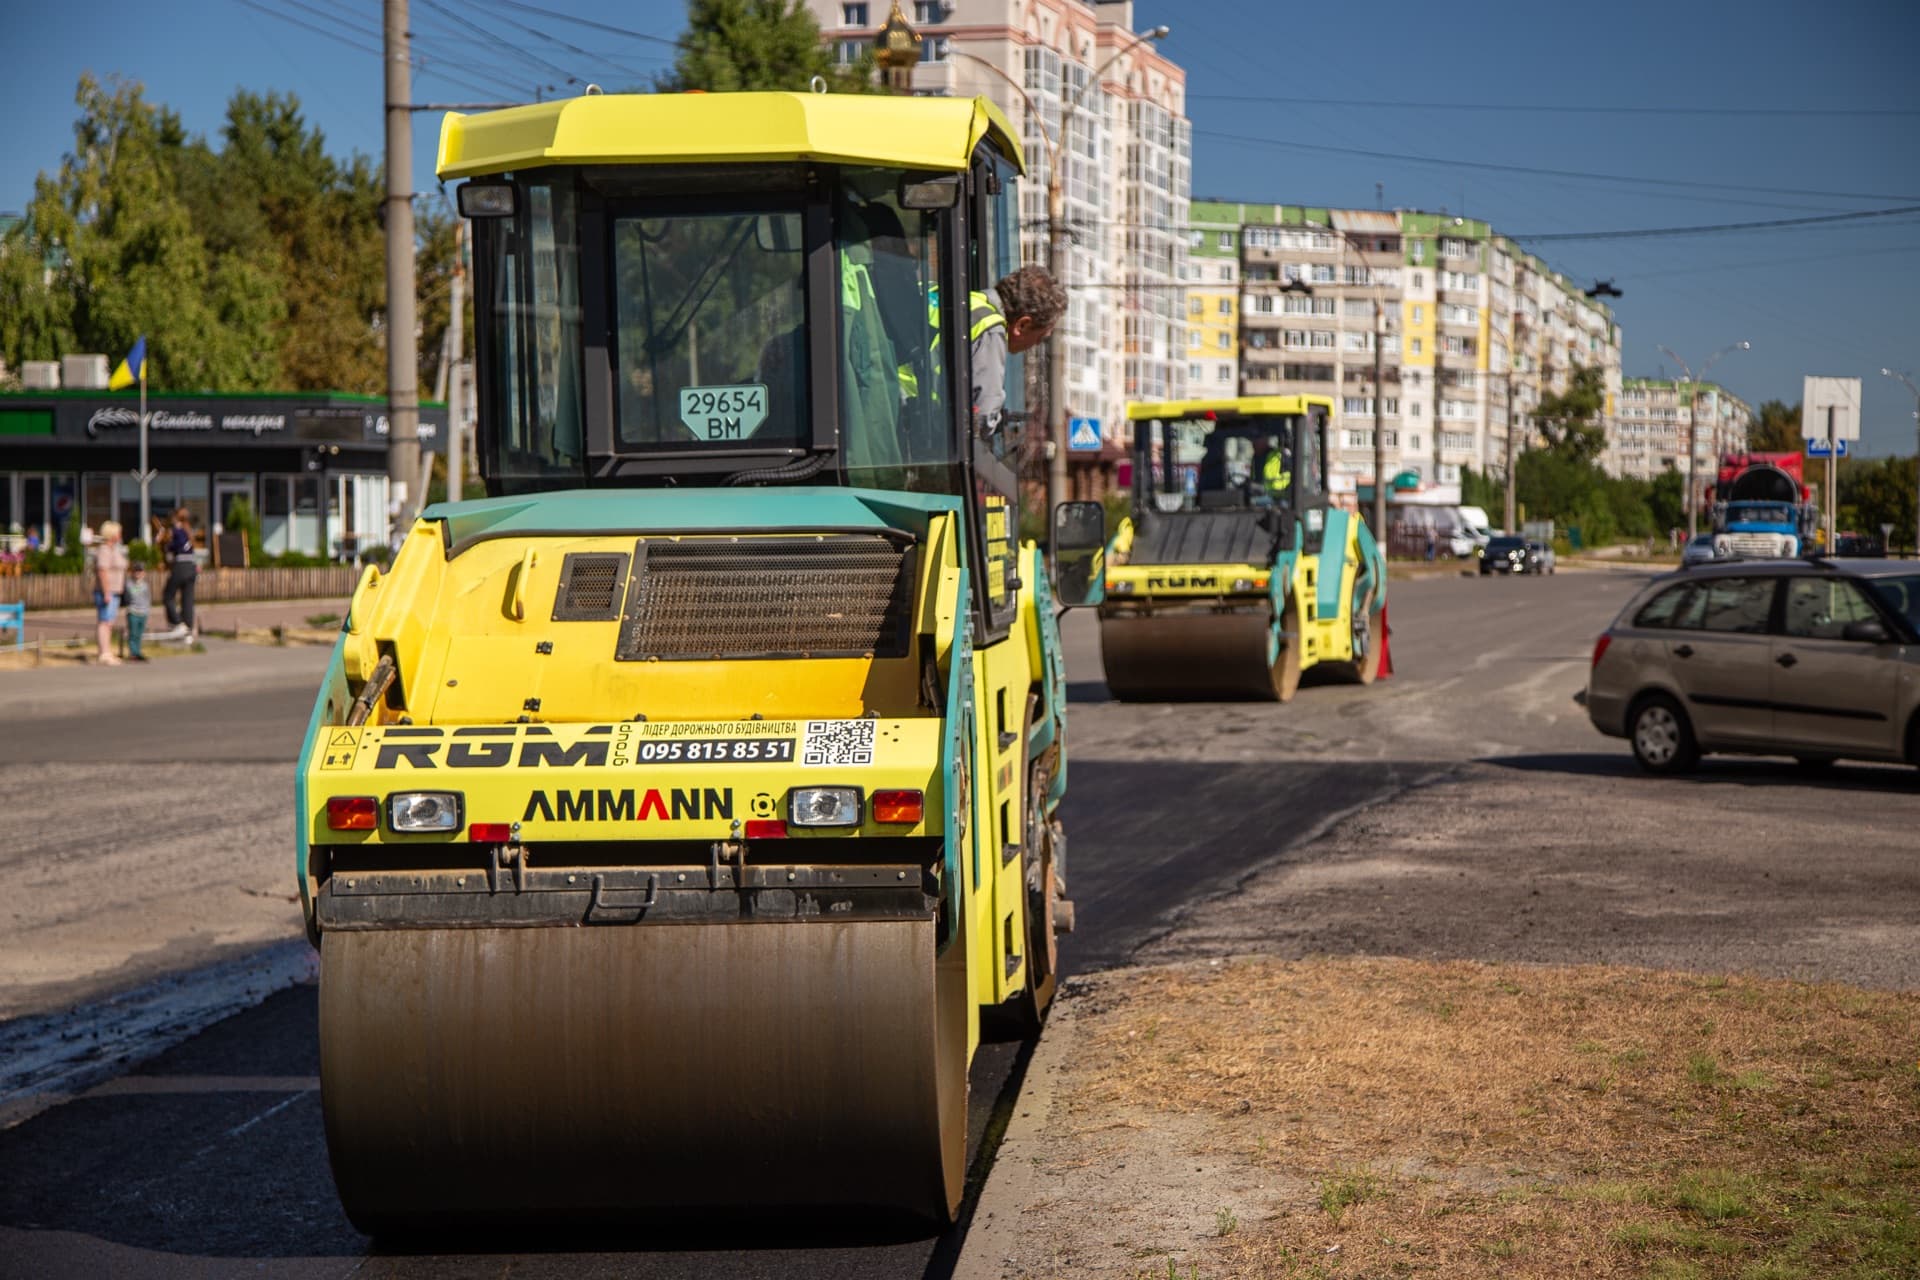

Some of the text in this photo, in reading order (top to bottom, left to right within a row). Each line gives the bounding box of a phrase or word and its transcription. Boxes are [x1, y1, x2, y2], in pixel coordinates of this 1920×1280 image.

[687, 391, 761, 414] 29654
[642, 721, 797, 737] ЛІДЕР ДОРОЖНЬОГО БУДІВНИЦТВА
[374, 725, 614, 770] RGM
[612, 724, 633, 767] group
[641, 741, 791, 760] 095 815 85 51
[521, 787, 734, 822] AMMANN
